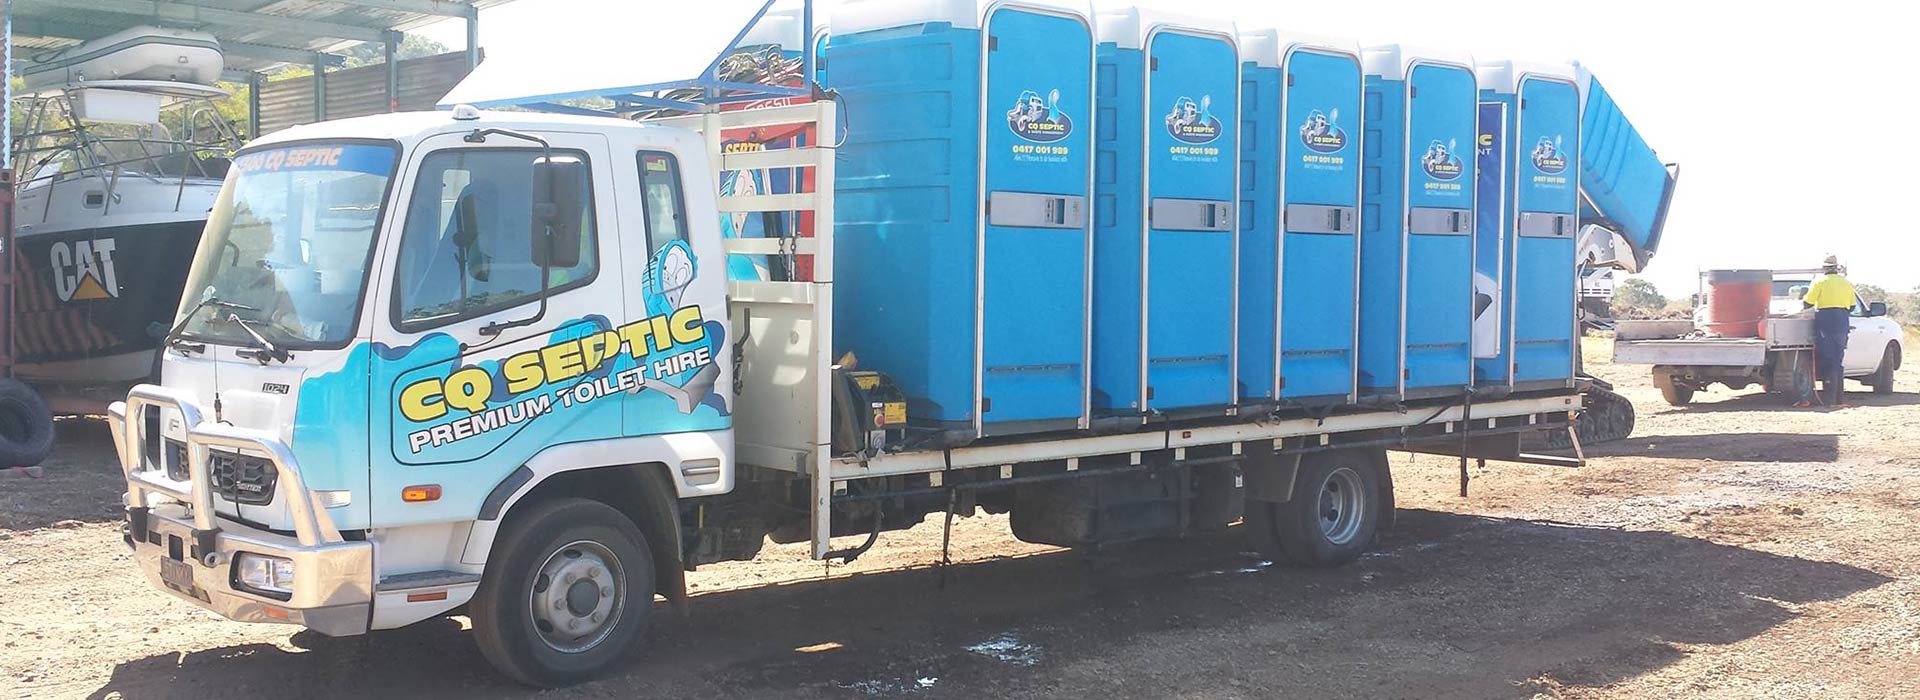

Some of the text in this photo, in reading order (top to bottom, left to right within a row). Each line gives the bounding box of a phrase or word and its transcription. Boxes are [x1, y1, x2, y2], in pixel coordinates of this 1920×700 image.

[1039, 123, 1065, 131] SEPTIC
[1193, 126, 1215, 134] SEPTIC
[1012, 145, 1034, 154] 0417
[1035, 145, 1051, 154] 001
[265, 151, 285, 170] CQ
[285, 148, 344, 167] SEPTIC
[50, 238, 119, 301] CAT
[400, 305, 705, 423] CQ SEPTIC
[262, 383, 289, 394] 1024
[408, 345, 713, 454] PREMIUM TOILET HIRE
